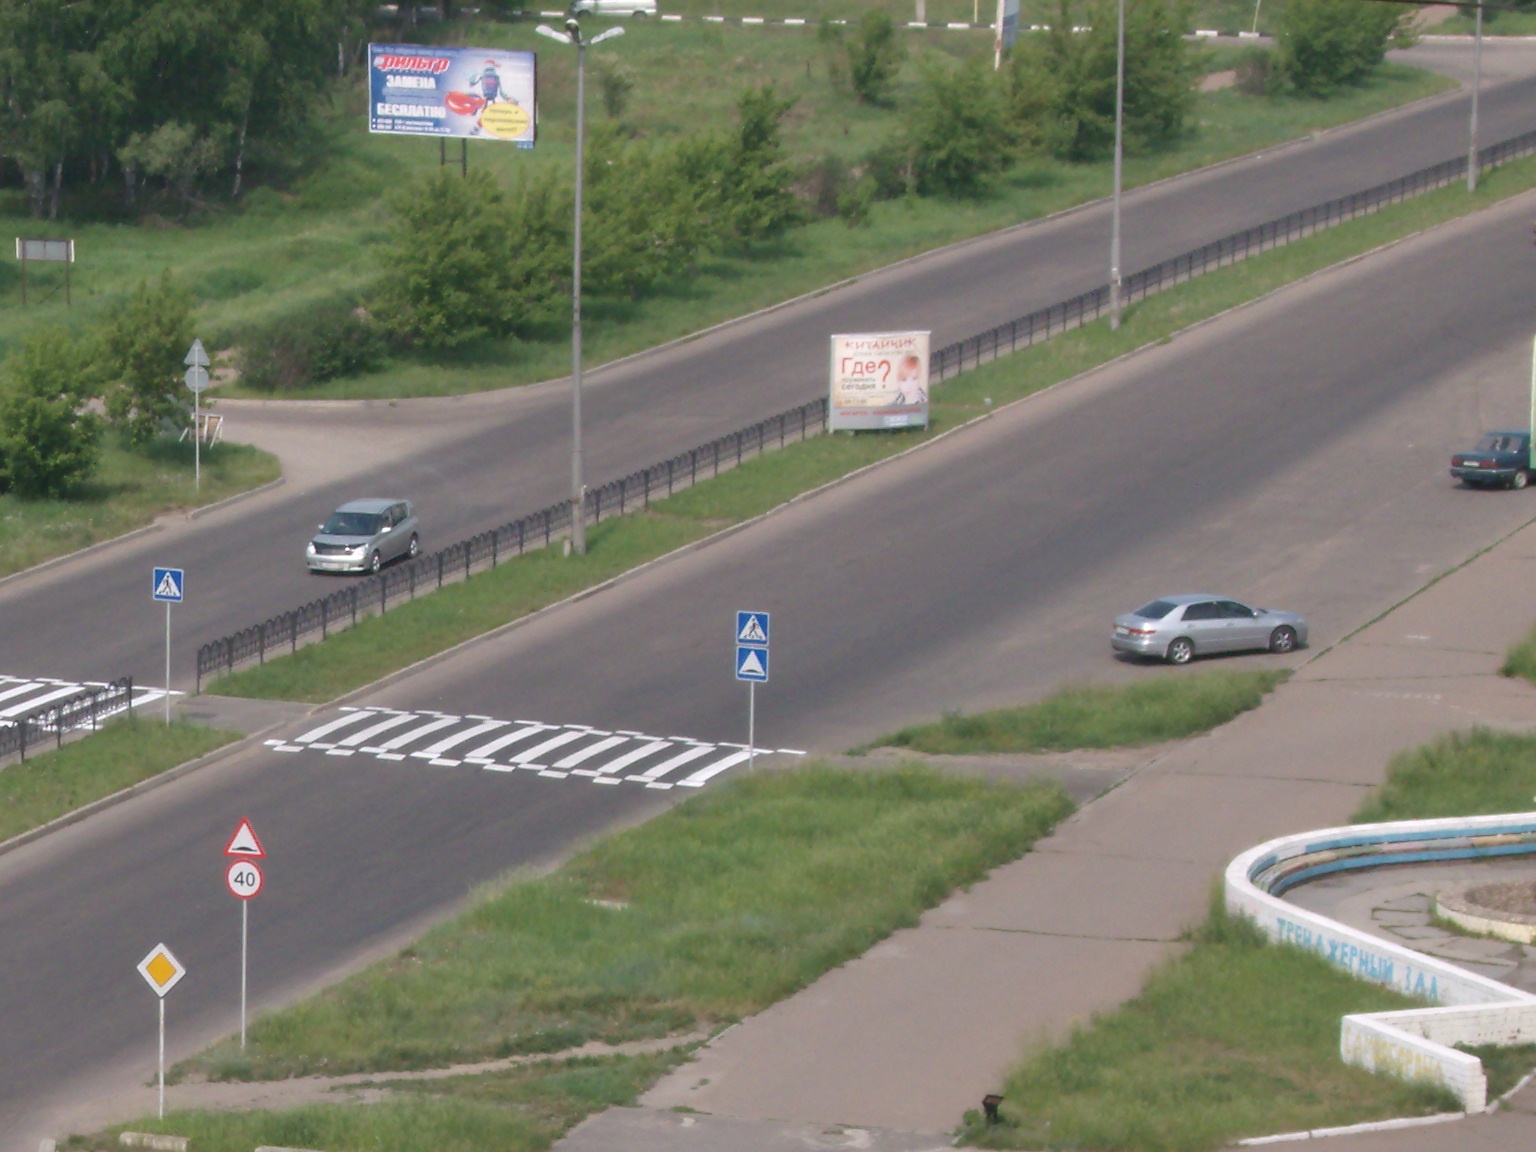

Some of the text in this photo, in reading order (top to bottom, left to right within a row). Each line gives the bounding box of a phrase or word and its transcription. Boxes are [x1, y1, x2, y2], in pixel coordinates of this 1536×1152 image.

[386, 75, 436, 89] ЗАМЕНА
[376, 102, 446, 118] БЕСПЛАТНО
[841, 357, 891, 388] Где?
[234, 871, 255, 886] 40
[1406, 965, 1439, 1001] ЗАЛ
